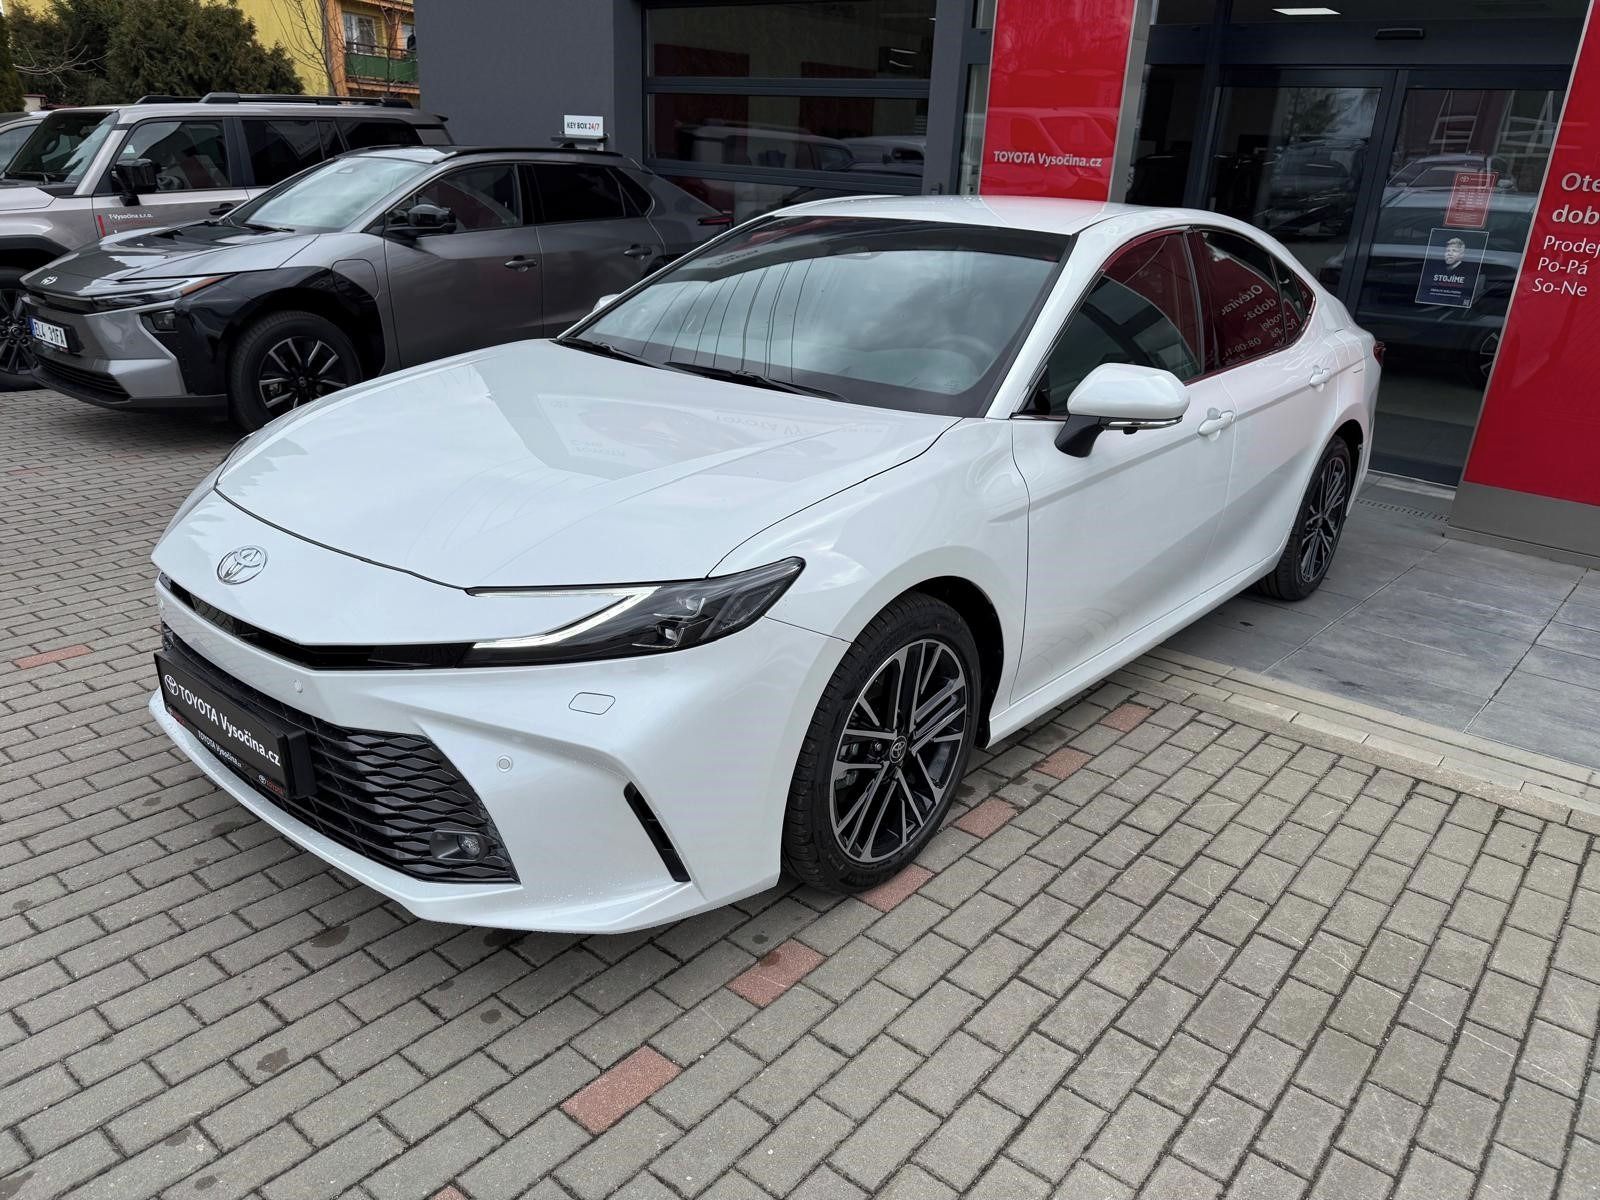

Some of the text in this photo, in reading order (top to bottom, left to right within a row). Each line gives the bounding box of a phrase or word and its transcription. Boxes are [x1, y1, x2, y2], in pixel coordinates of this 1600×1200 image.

[577, 122, 588, 130] BOX
[588, 122, 600, 131] 24/7
[993, 150, 1103, 167] TOYOTA Vysočina.cz
[1538, 257, 1589, 275] Po-Pá
[1433, 273, 1465, 284] STOJÍME
[1532, 278, 1588, 297] So-Ne
[178, 684, 281, 767] TOYOTA Vysočina.cz
[198, 730, 216, 749] TOYOTA
